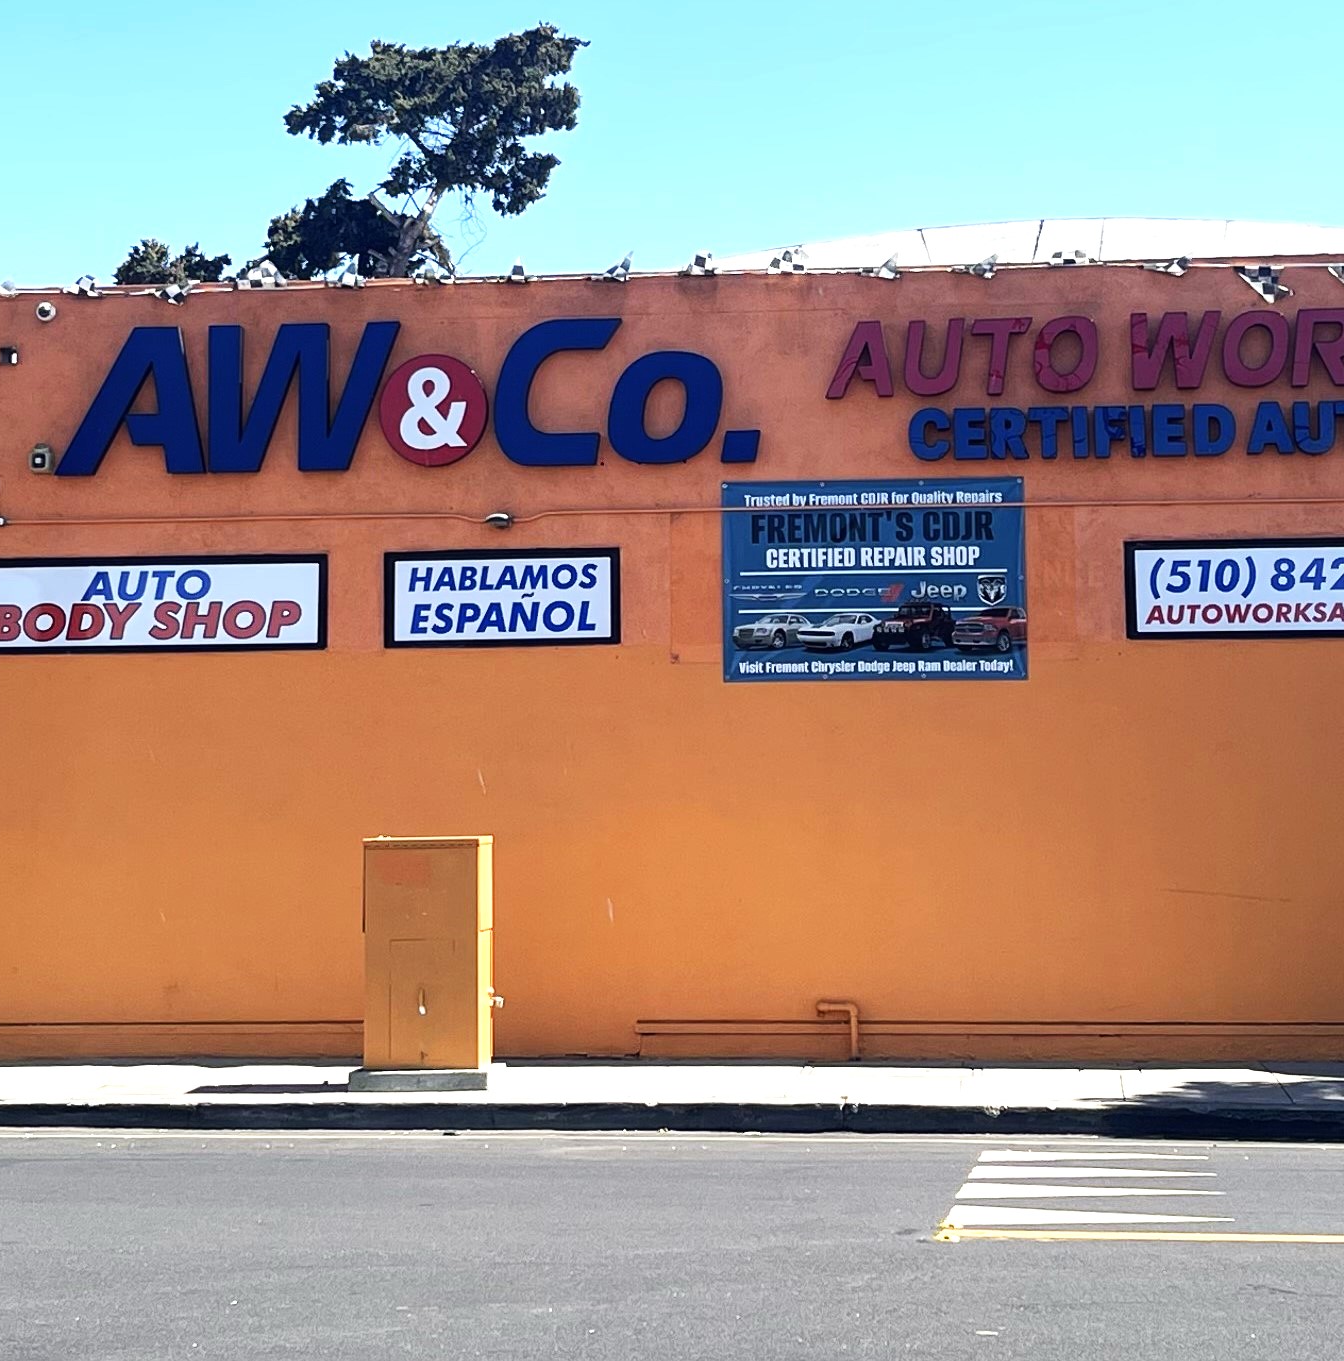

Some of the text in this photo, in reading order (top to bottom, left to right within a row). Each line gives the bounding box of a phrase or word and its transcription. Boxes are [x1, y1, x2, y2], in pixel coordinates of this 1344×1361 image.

[825, 314, 1099, 399] AUTO
[55, 317, 761, 477] AW&Co.
[908, 403, 1236, 462] CERTIFIED
[743, 489, 1003, 507] Trusted by Fremont CDJR for Quality Repairs
[751, 510, 994, 545] FREMONT'S CDJR
[766, 545, 980, 569] CERTIFIED REPAIR SHOP
[81, 569, 212, 601] AUTO
[408, 563, 598, 592] HABLAMOS
[814, 586, 892, 597] DODGE
[910, 580, 968, 601] Jeep
[1149, 555, 1257, 599] (510)
[148, 599, 303, 639] SHOP
[409, 592, 597, 635] ESPAÑOL
[739, 659, 1014, 674] Visit Fremont Chrysler Dodge Jeep Ram Dealer Today!
